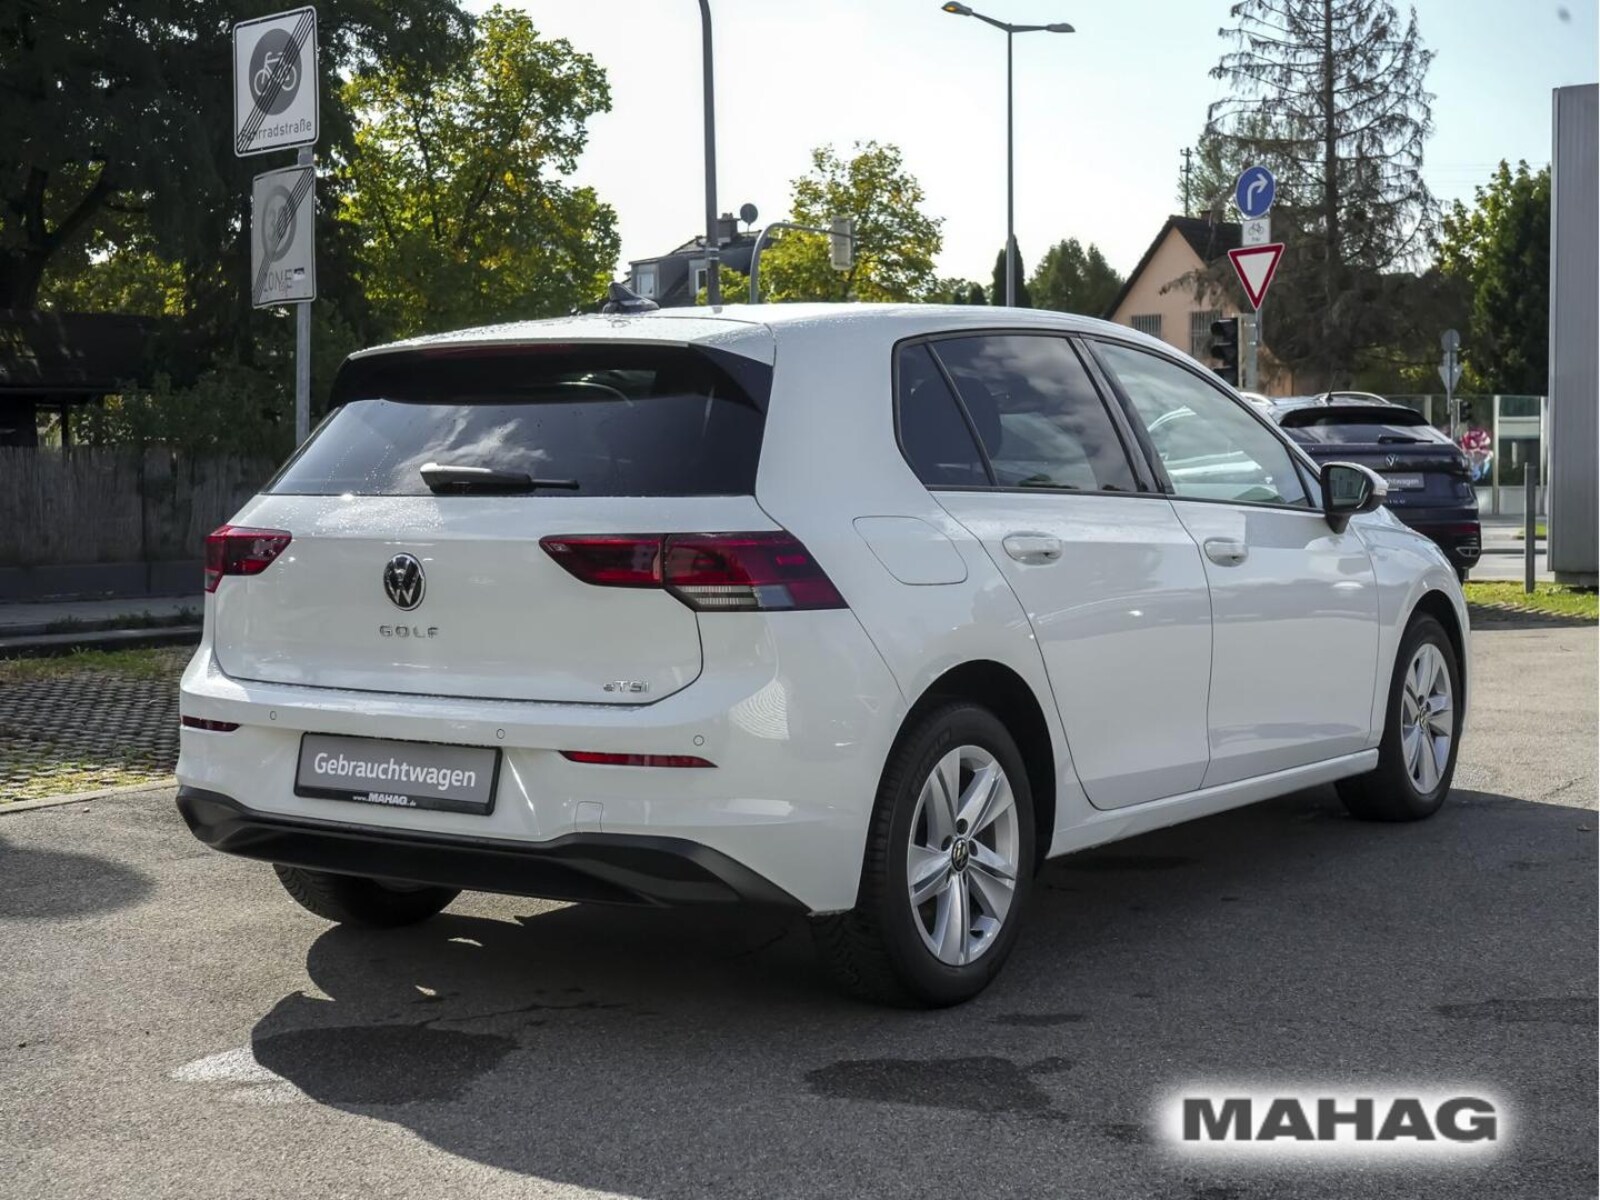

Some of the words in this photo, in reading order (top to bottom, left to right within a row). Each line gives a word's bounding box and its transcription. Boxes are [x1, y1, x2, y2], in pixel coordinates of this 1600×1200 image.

[241, 118, 312, 141] rradstraße
[254, 268, 293, 292] ONE
[379, 625, 439, 638] GOLF
[313, 752, 477, 791] Gebrauchtwagen
